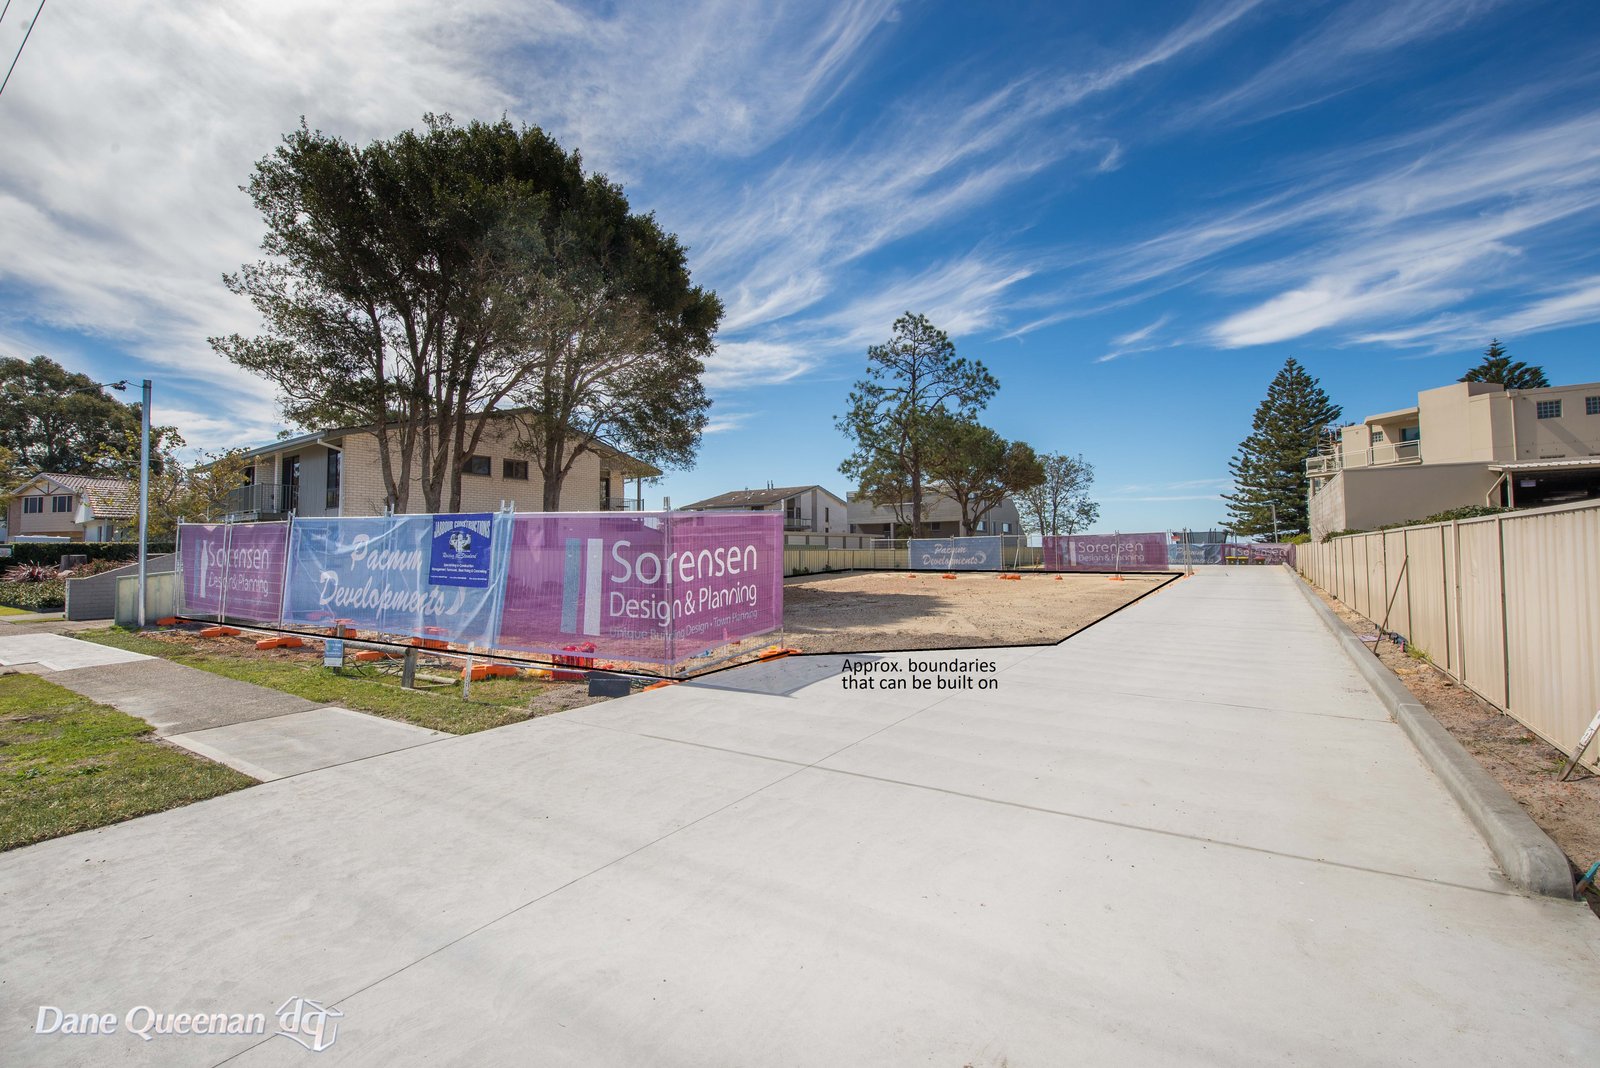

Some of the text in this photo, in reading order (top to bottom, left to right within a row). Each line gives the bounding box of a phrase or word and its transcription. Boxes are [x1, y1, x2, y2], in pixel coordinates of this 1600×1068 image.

[454, 520, 491, 538] CONSTRUCTIONS
[1078, 542, 1144, 553] Sorensen
[1078, 554, 1104, 562] Design
[1111, 554, 1144, 562] Panning
[610, 540, 757, 585] Sorensen
[238, 574, 268, 598] Planning
[320, 570, 446, 619] Developments
[609, 581, 757, 627] Design & Planning
[610, 626, 648, 641] Unique
[686, 622, 709, 636] Design
[713, 616, 730, 626] Town
[732, 609, 758, 624] Planning
